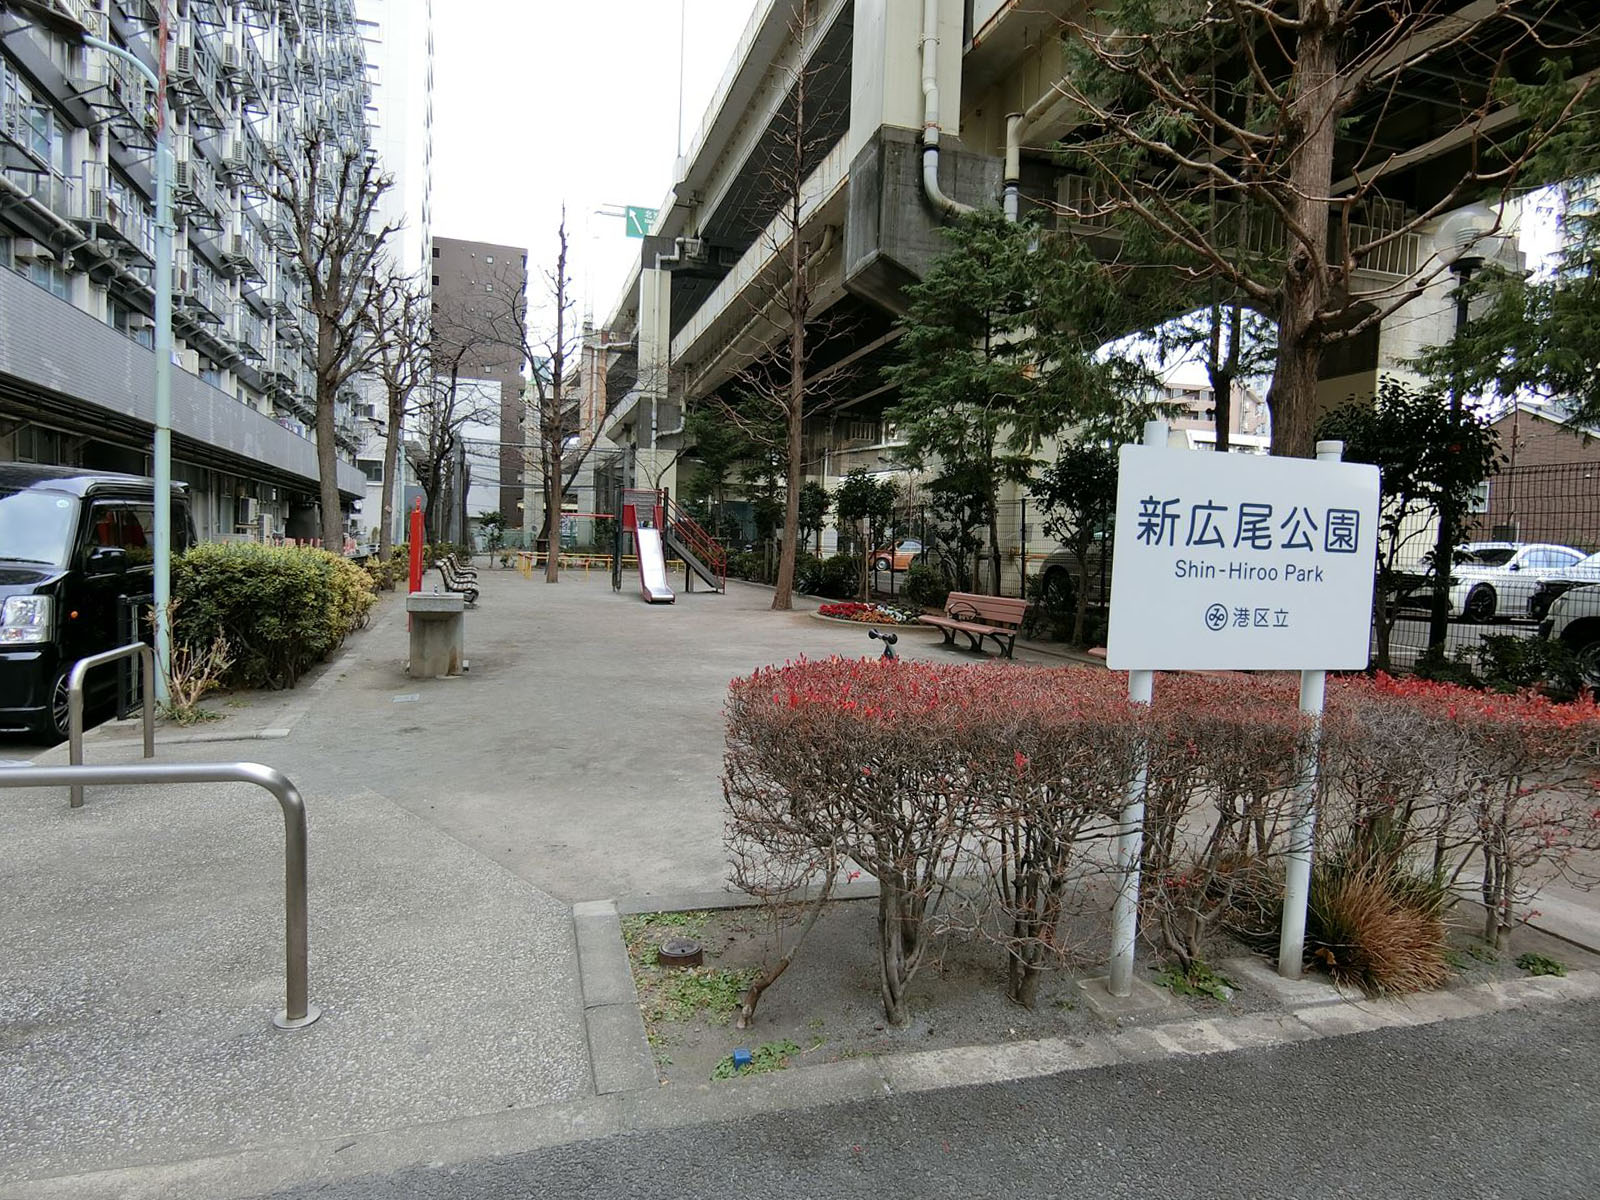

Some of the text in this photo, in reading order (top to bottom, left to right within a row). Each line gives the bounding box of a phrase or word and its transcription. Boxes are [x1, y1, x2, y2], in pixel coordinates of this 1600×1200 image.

[1137, 495, 1360, 554] 新広尾公園
[1174, 559, 1324, 583] Shin-Hiroo Park
[1232, 607, 1289, 628] 港区立
